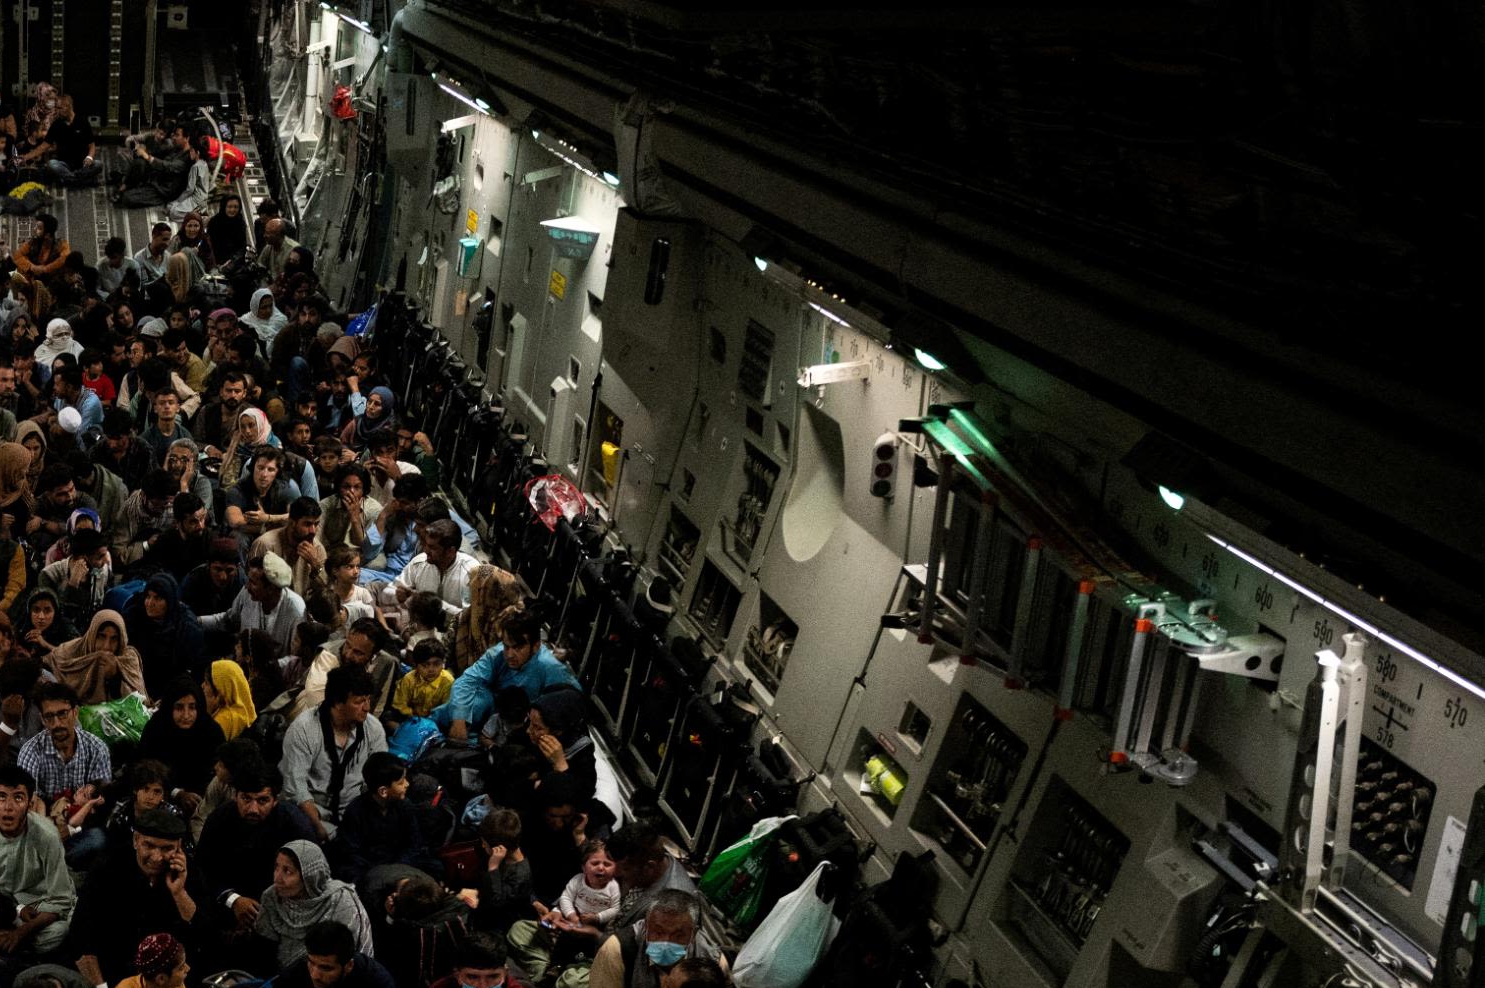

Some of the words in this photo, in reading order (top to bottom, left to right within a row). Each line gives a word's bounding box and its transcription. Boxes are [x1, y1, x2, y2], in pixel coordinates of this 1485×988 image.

[1255, 586, 1273, 609] 600
[1314, 621, 1333, 645] 590
[1376, 655, 1397, 682] 580
[1374, 684, 1415, 716] COMPARTMENT
[1444, 699, 1467, 726] 570
[1376, 726, 1393, 749] 578
